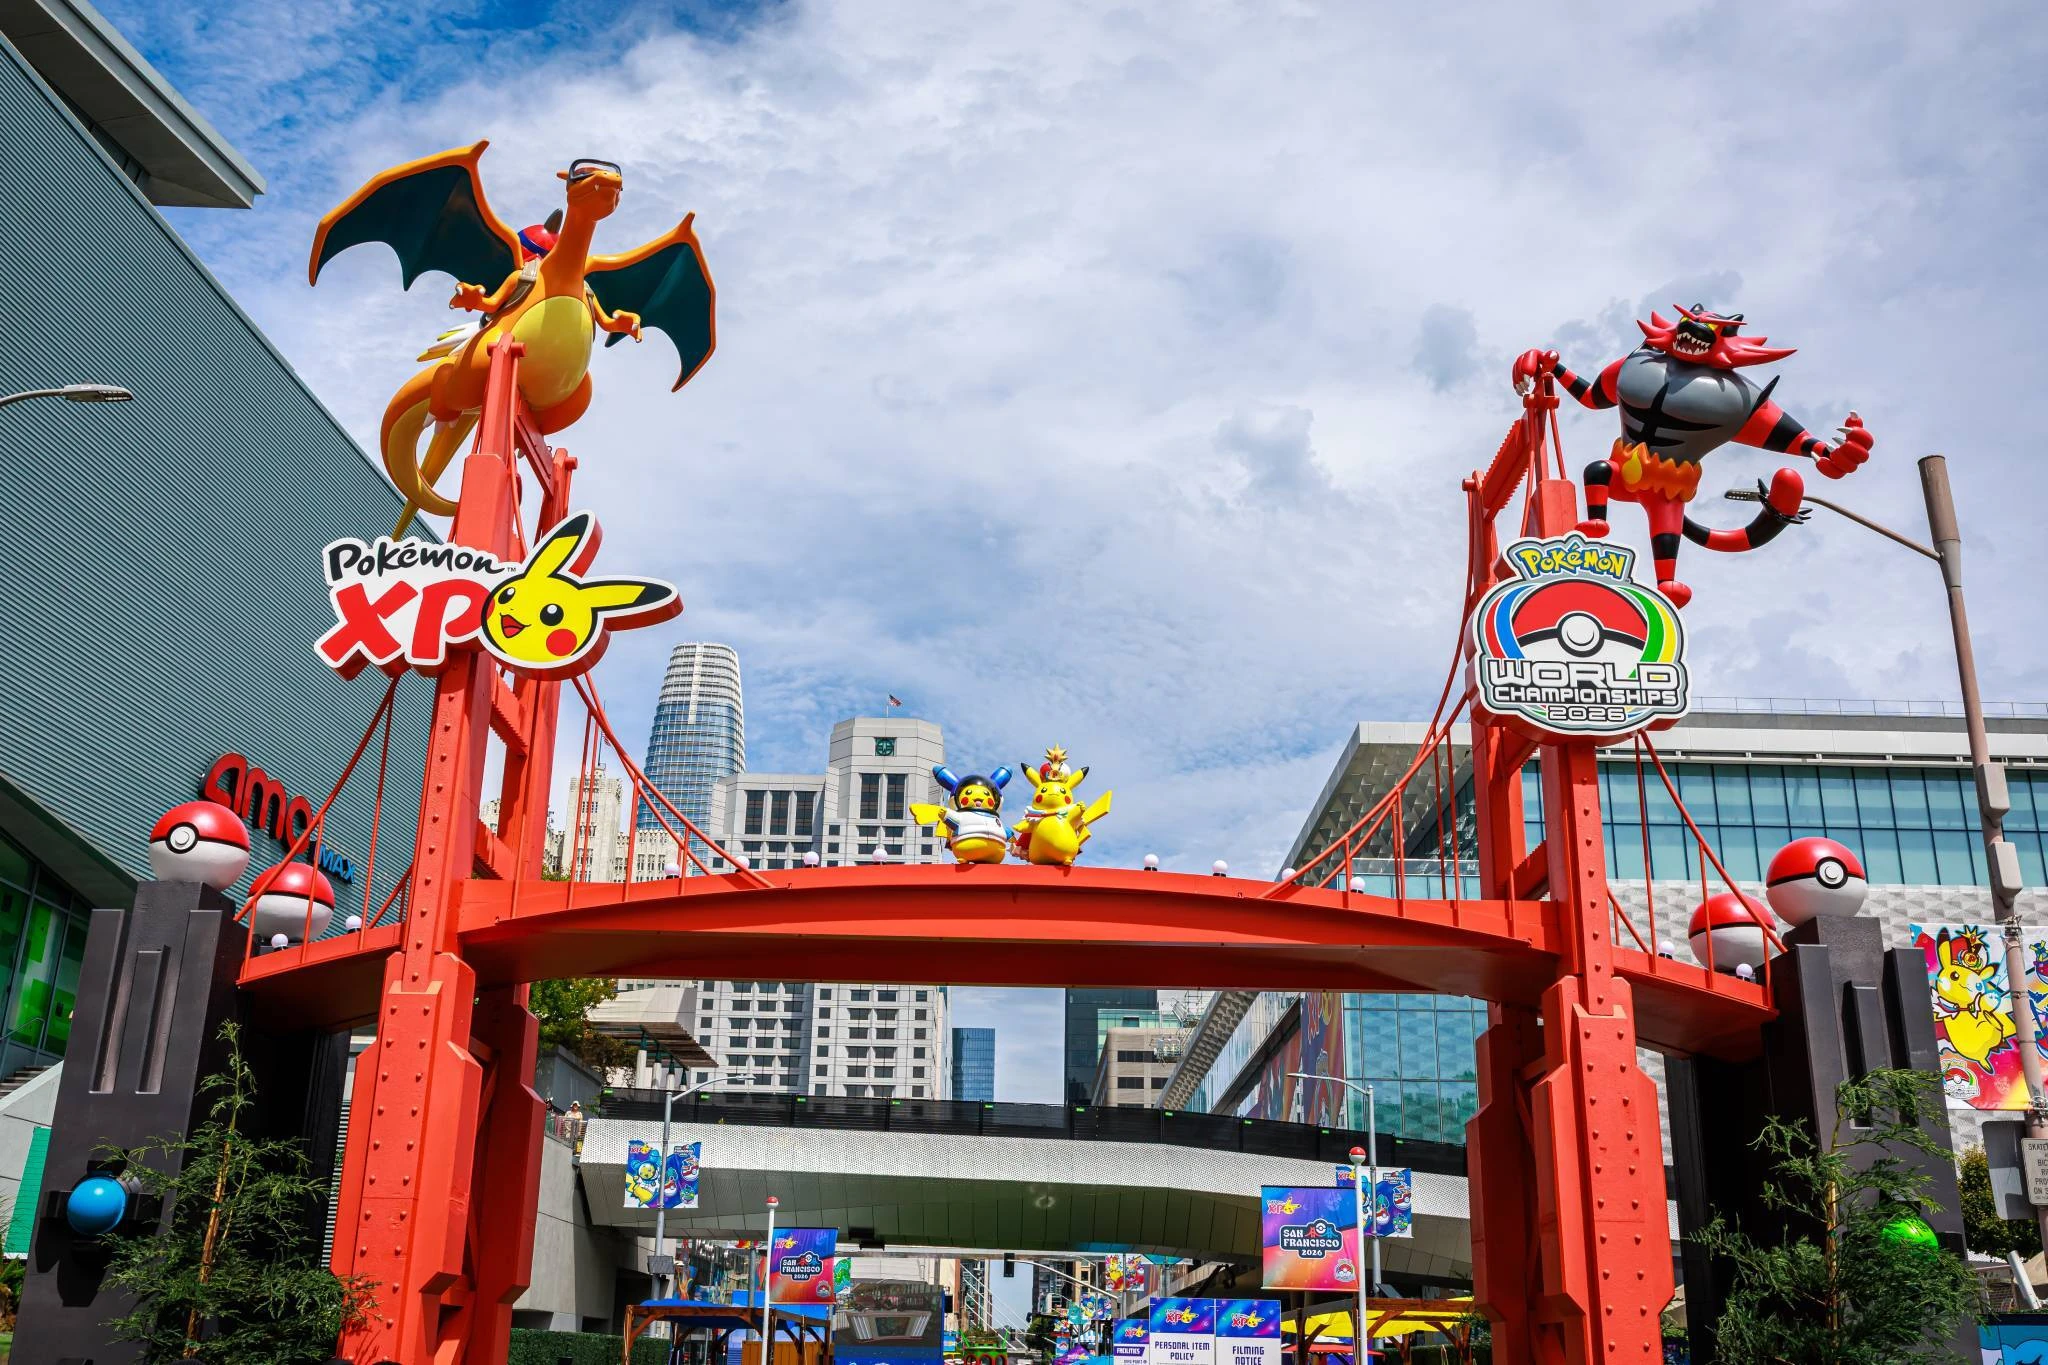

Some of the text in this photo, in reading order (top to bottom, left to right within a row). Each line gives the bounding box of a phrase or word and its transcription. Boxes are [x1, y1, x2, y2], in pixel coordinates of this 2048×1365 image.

[329, 543, 505, 581] Pokémon
[320, 578, 492, 660] XP
[1487, 658, 1679, 690] WORLD
[1493, 687, 1678, 706] CHAMPIONSHIPS
[1547, 705, 1627, 722] 2026
[313, 842, 356, 884] MAX
[1283, 1229, 1303, 1238] SAN
[1283, 1238, 1340, 1248] FRANCISCO
[1154, 1341, 1210, 1351] PERSONAL ITEM
[1232, 1345, 1265, 1355] FILMING
[1170, 1351, 1194, 1360] POLICY
[1235, 1356, 1262, 1365] NOTICE
